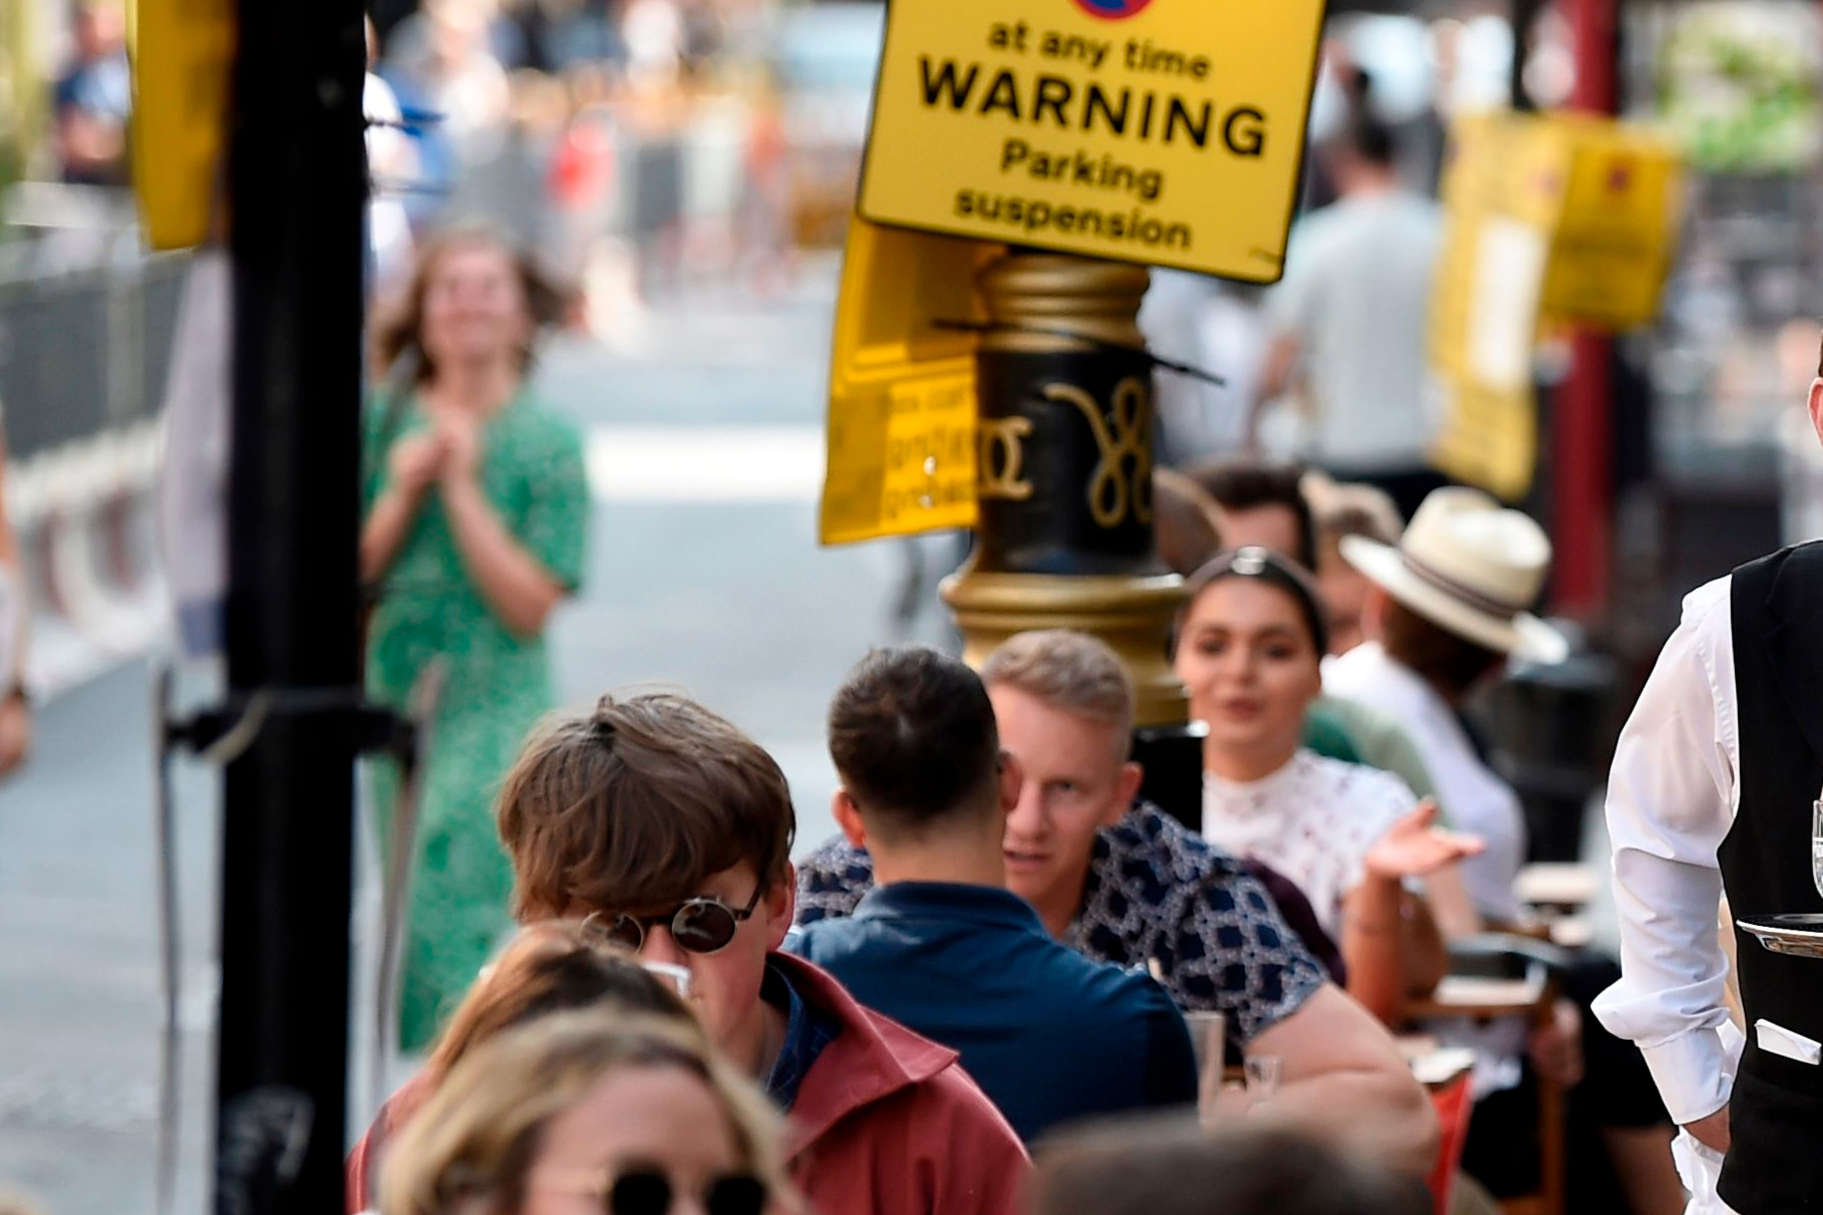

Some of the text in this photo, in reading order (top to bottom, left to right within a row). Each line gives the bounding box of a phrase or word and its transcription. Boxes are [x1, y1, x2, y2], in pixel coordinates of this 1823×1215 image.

[989, 19, 1211, 80] at any time
[918, 56, 1269, 158] WARNING
[1000, 138, 1164, 201] Parking
[954, 188, 1192, 248] suspension
